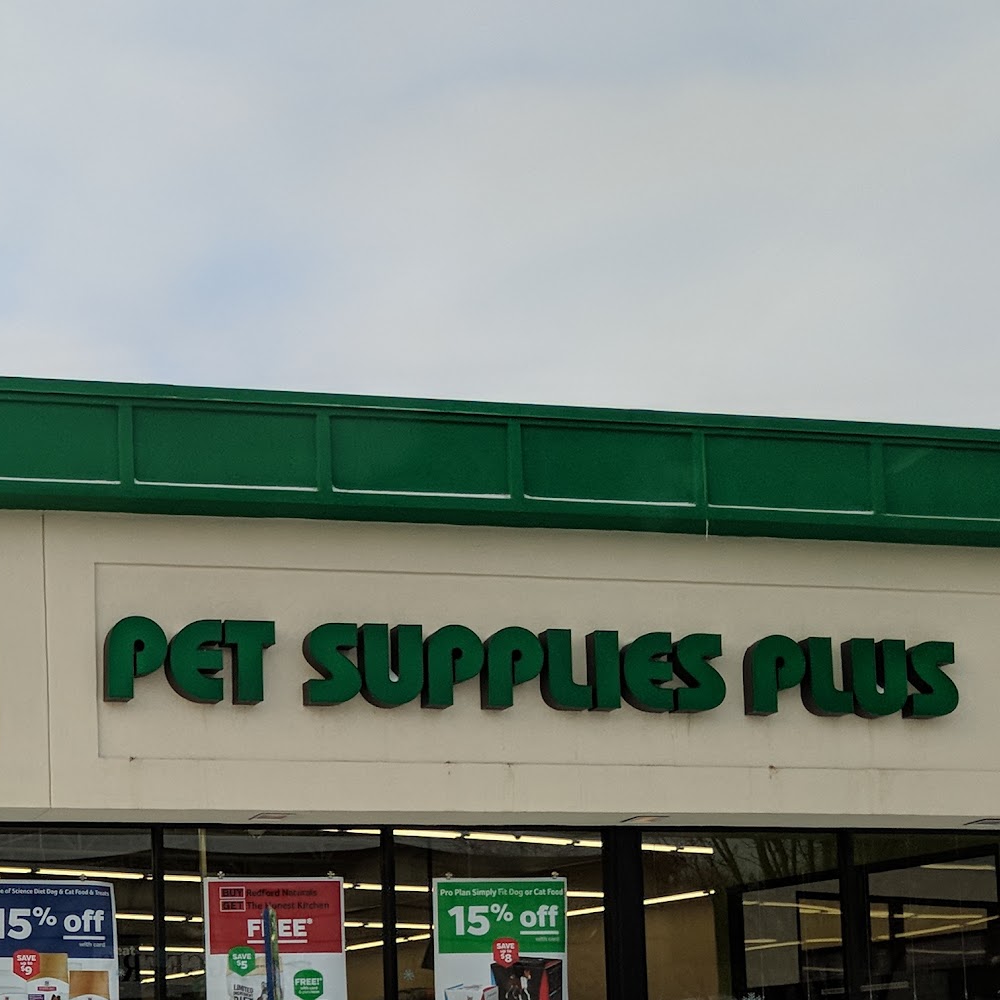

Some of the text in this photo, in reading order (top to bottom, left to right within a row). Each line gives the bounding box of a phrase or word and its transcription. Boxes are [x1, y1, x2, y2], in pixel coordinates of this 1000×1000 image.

[103, 615, 959, 719] PET SUPPLIES PLUS
[4, 887, 12, 895] of
[11, 887, 33, 895] Science
[46, 888, 58, 897] Dog
[222, 888, 318, 897] BUY Redford Naturals
[440, 888, 453, 896] Pro
[455, 888, 471, 896] Plan
[472, 888, 497, 897] Simply
[509, 888, 523, 897] Dog
[534, 888, 546, 896] Cat
[222, 901, 244, 910] GET
[247, 901, 263, 909] The
[297, 901, 330, 909] Kitchen
[63, 909, 105, 933] off
[447, 903, 559, 936] 15% off
[247, 917, 313, 937] FEE
[16, 954, 37, 962] SAVE
[500, 954, 512, 963] $8
[236, 960, 248, 970] $5
[20, 965, 33, 976] $9
[233, 984, 254, 993] LIMITED
